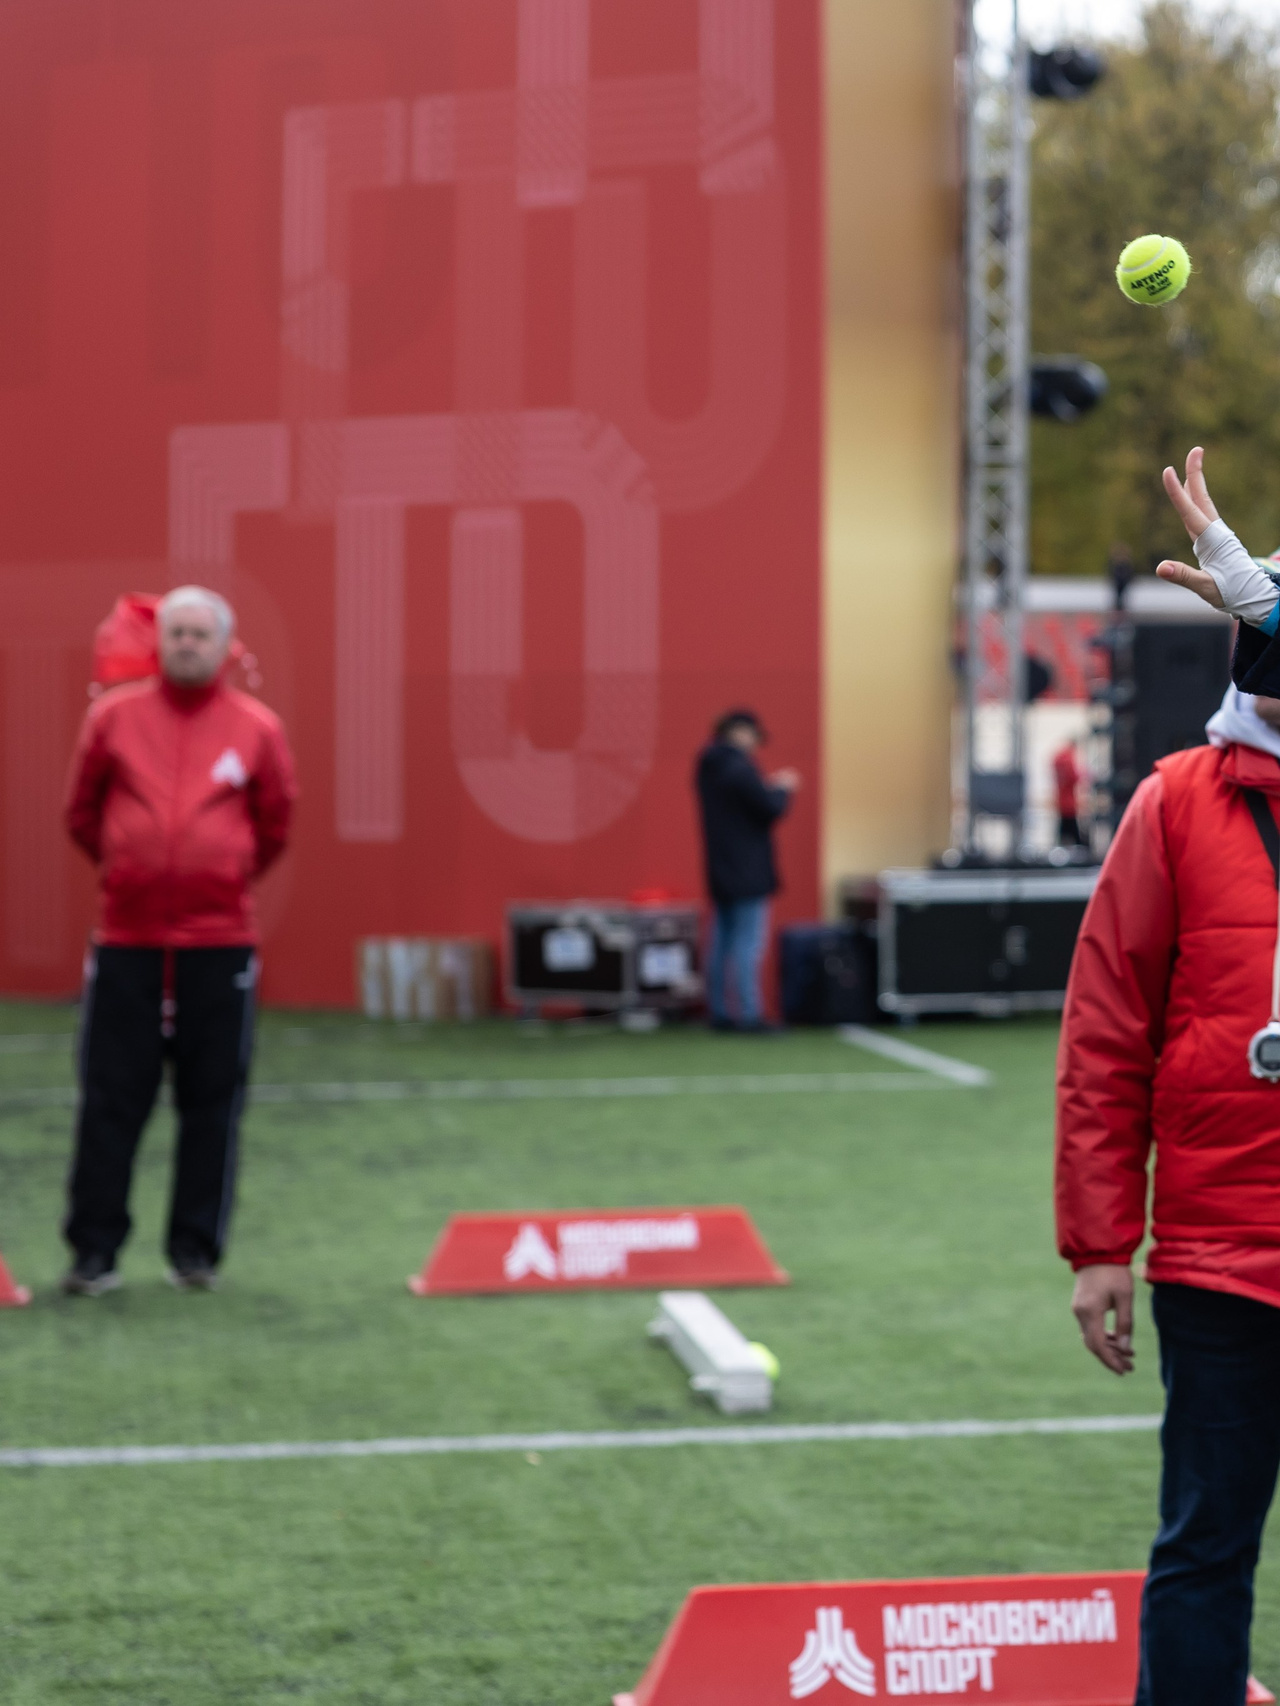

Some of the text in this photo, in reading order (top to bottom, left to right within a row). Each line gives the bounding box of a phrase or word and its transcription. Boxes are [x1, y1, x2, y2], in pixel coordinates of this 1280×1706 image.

[1130, 259, 1175, 290] ARTENGO
[883, 1588, 1116, 1648] МОСКОВСКИЙ
[885, 1647, 996, 1695] СПОРТ
